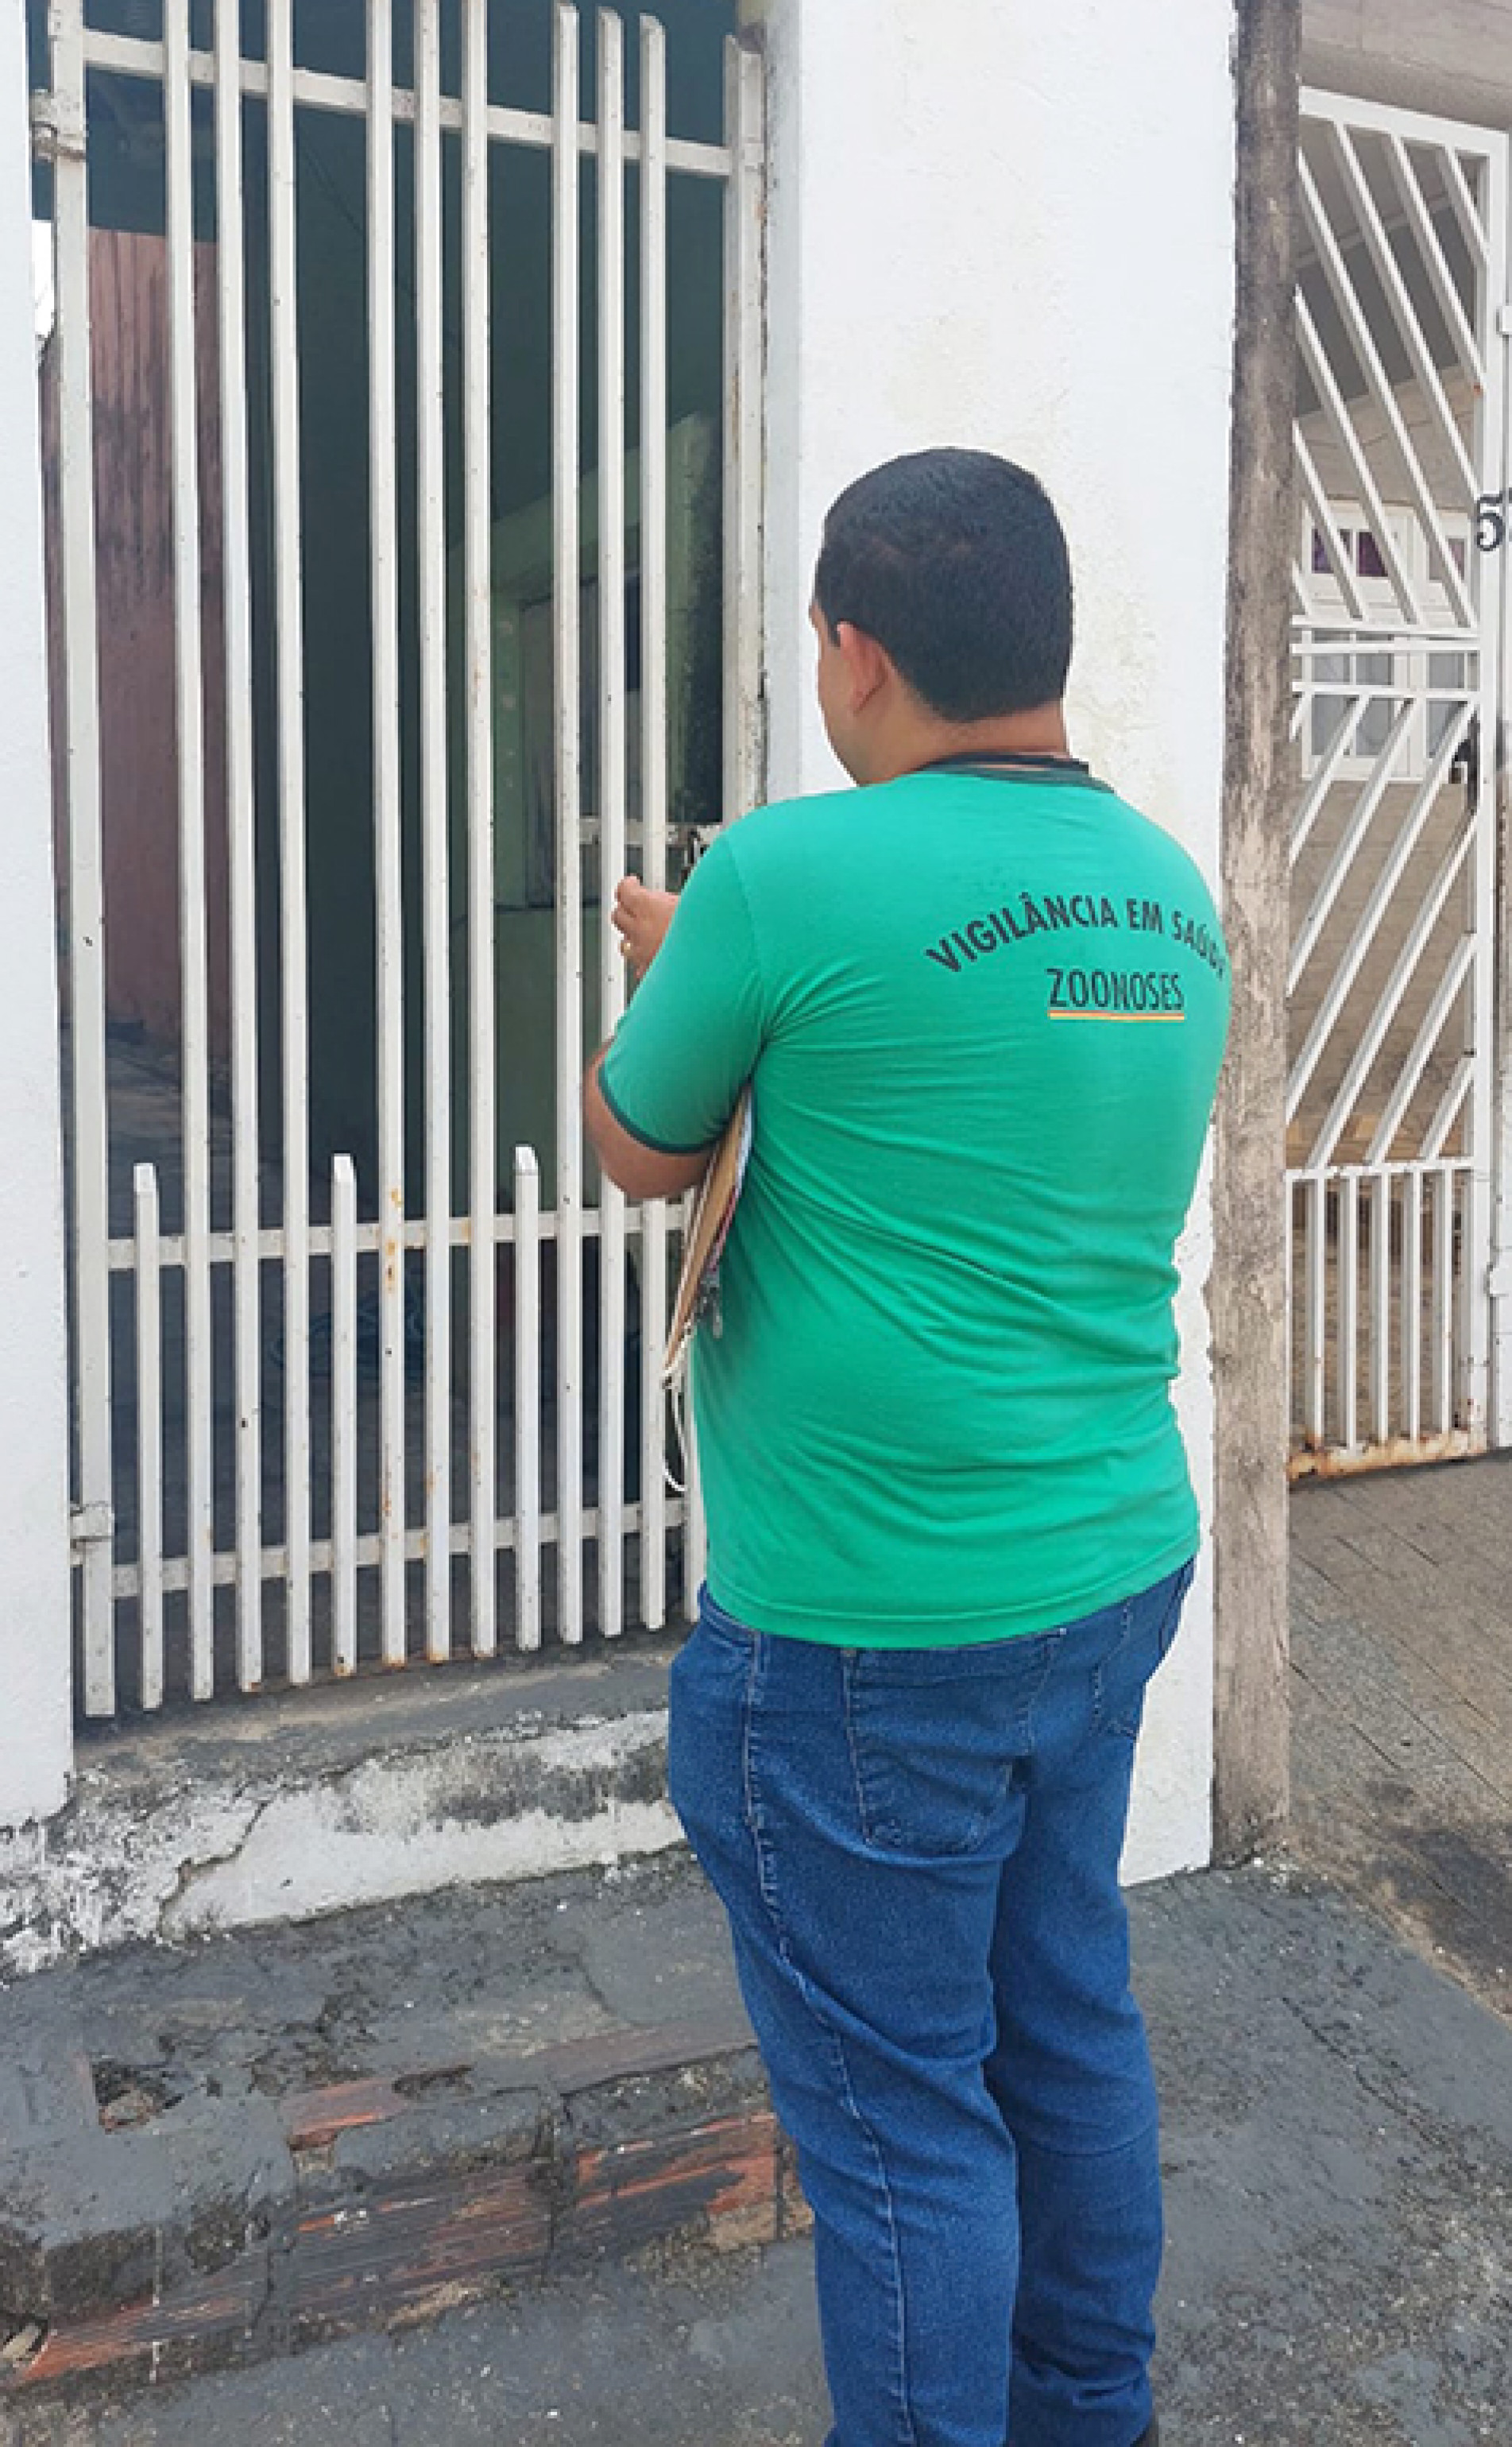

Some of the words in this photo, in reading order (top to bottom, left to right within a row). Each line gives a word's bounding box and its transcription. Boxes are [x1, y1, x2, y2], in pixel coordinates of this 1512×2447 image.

[924, 892, 1119, 972] VIGILÂNCIA
[1126, 898, 1163, 934] EM
[1045, 968, 1185, 1010] ZOONOSES
